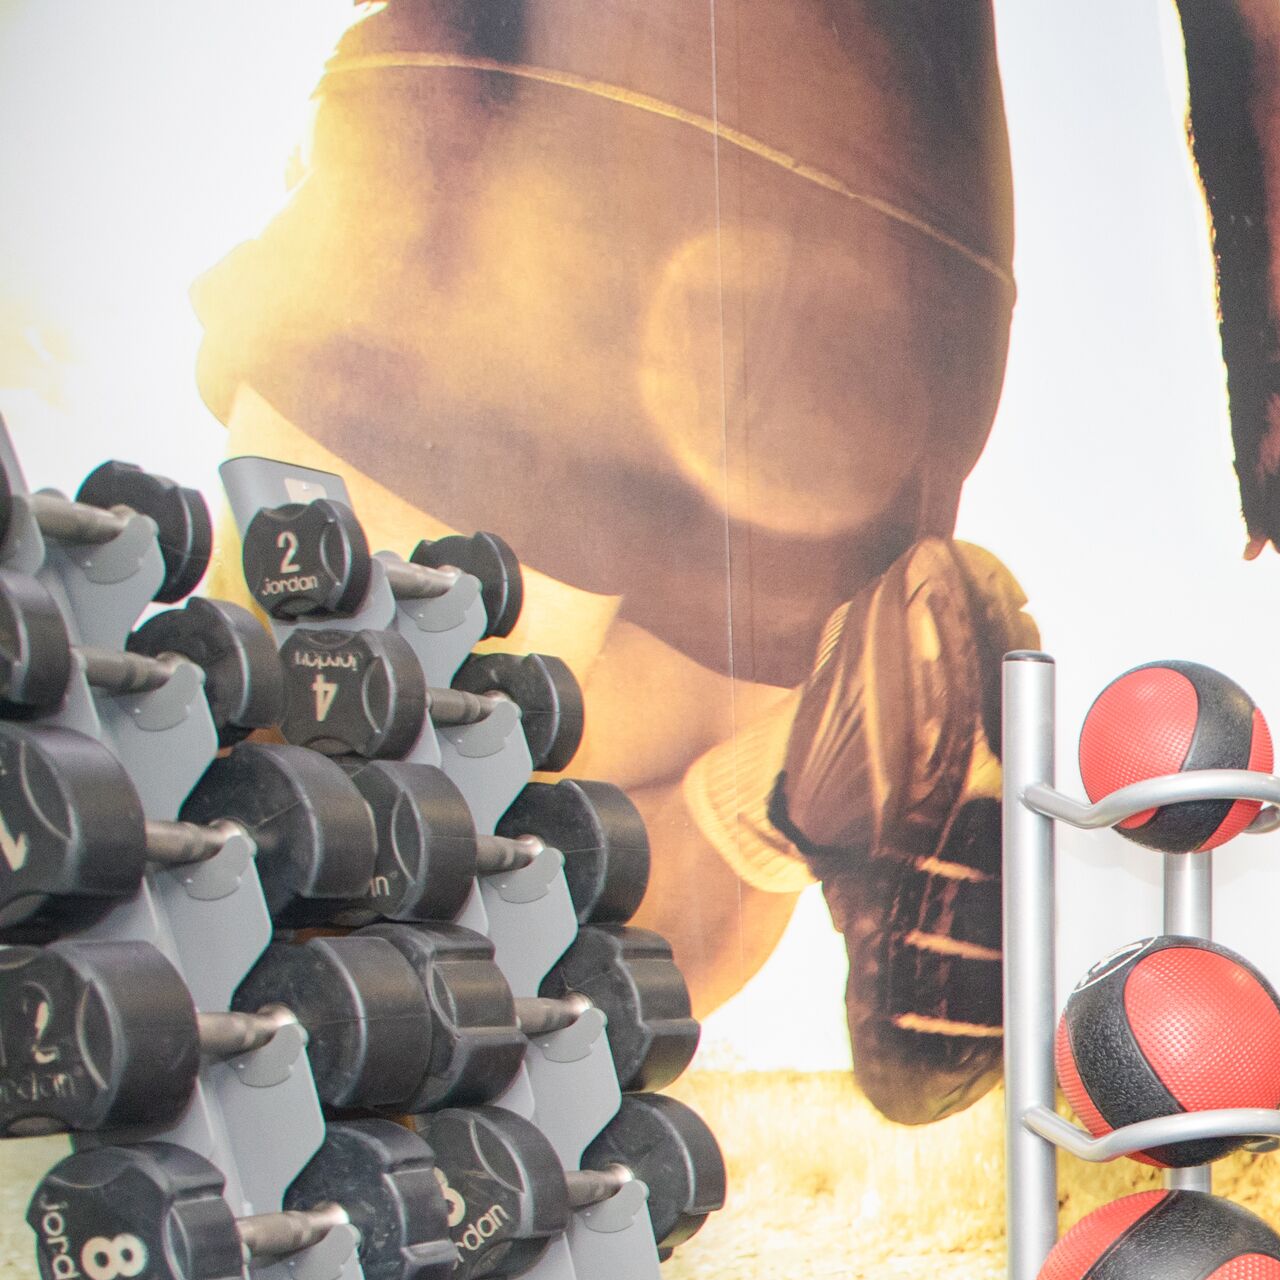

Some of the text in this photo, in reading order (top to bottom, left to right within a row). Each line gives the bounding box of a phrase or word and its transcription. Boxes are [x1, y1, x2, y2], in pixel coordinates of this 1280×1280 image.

[277, 531, 301, 575] 2
[261, 574, 319, 595] jordan
[313, 674, 339, 722] 4
